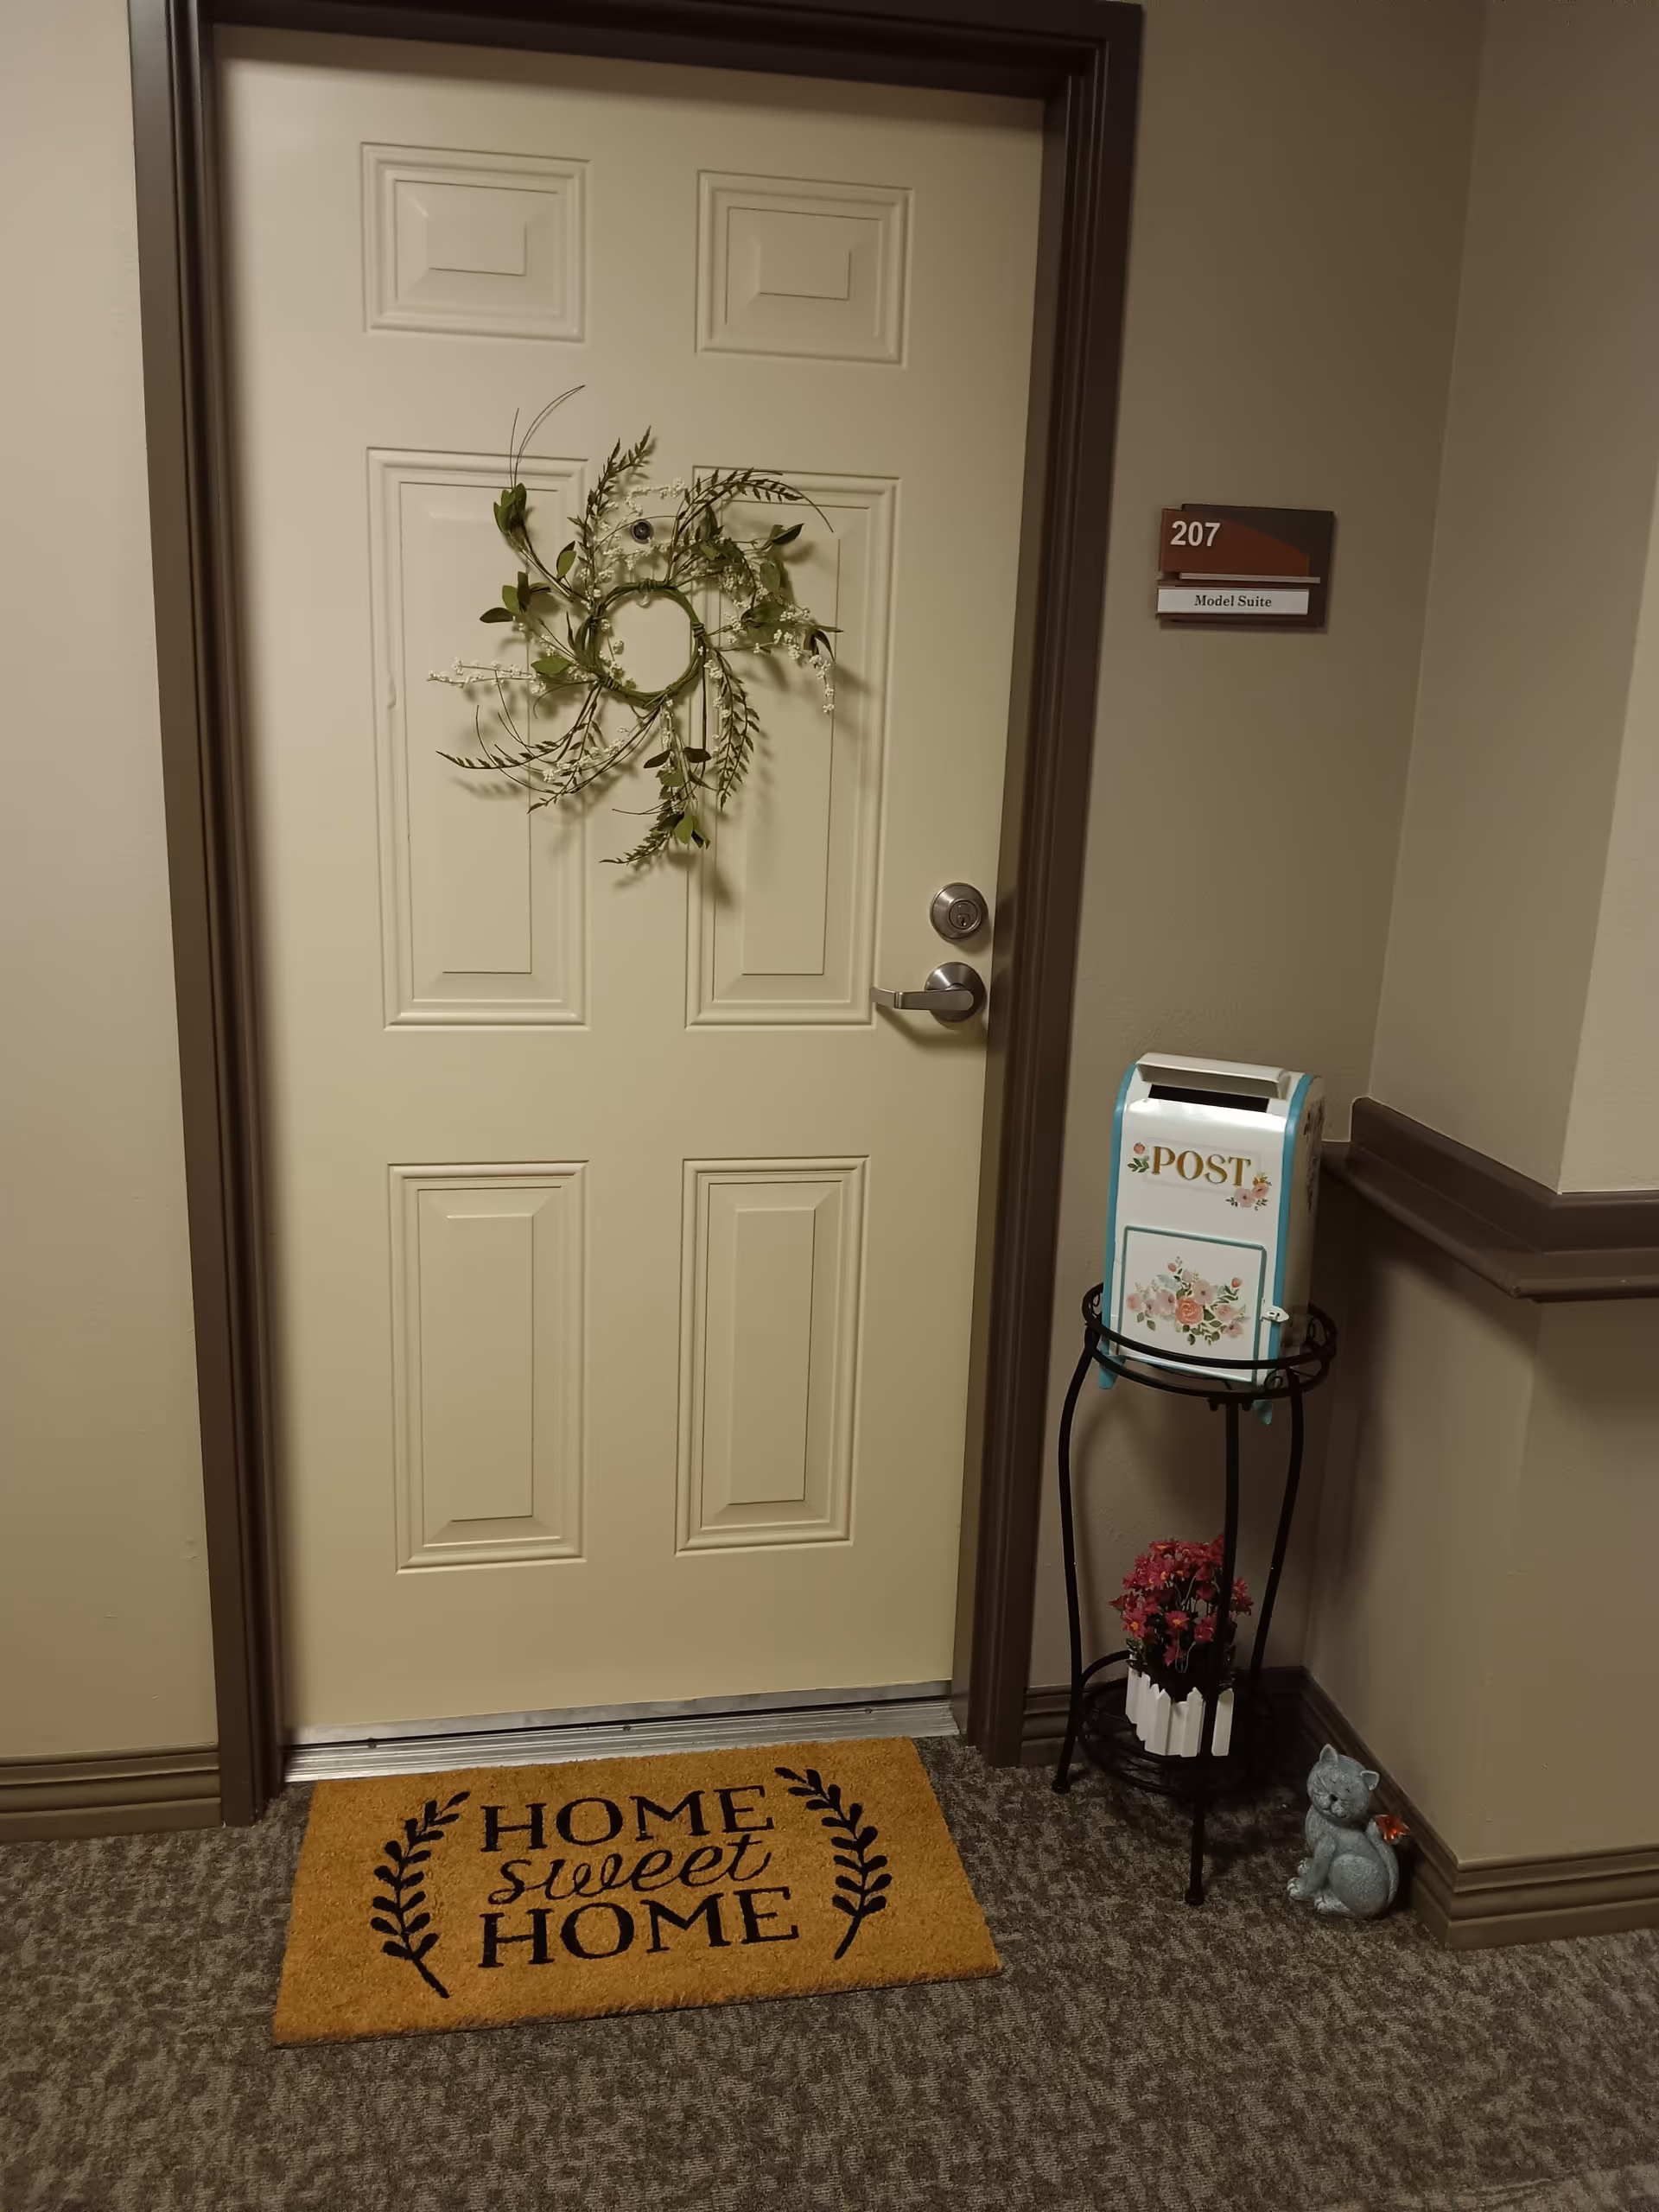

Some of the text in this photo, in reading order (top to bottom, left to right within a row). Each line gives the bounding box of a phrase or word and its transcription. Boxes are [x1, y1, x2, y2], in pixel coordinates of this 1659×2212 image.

[1170, 520, 1221, 547] 207
[1194, 594, 1272, 607] Model Suite
[1151, 1146, 1251, 1187] POST
[480, 1784, 775, 1853] HOME
[488, 1834, 772, 1905] sweet
[478, 1886, 799, 1968] HOME
